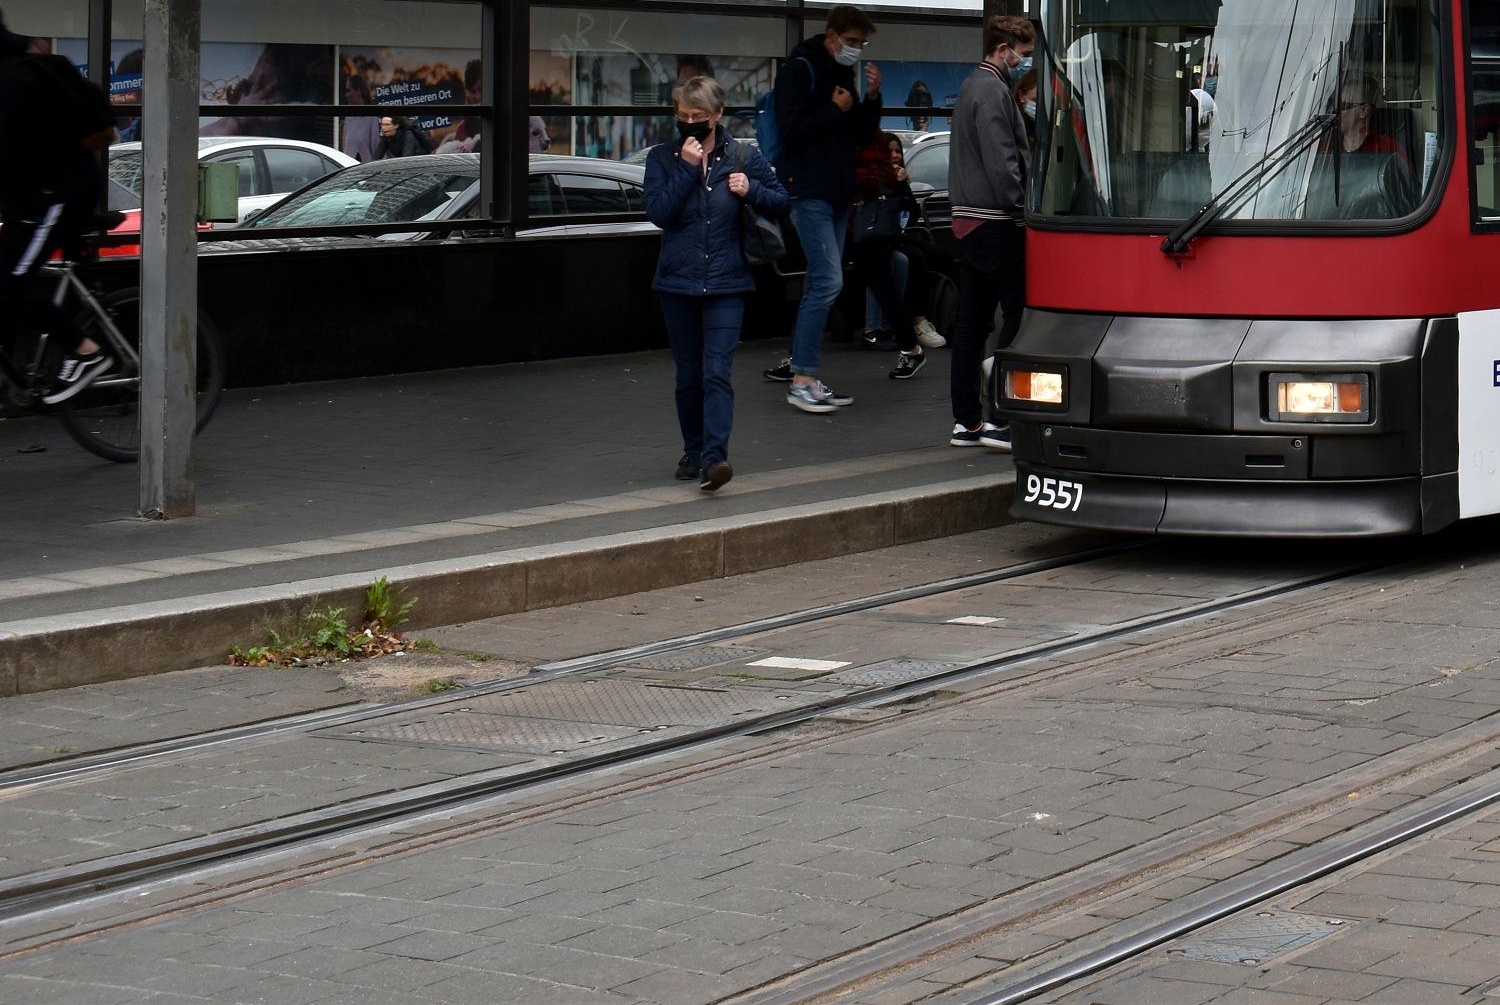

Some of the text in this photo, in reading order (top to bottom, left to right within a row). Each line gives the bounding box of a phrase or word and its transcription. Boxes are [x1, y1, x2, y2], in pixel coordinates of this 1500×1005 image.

[376, 82, 421, 97] Die Welt zu
[403, 93, 438, 106] besseren
[438, 89, 453, 100] Ort
[1023, 474, 1083, 512] 9551
